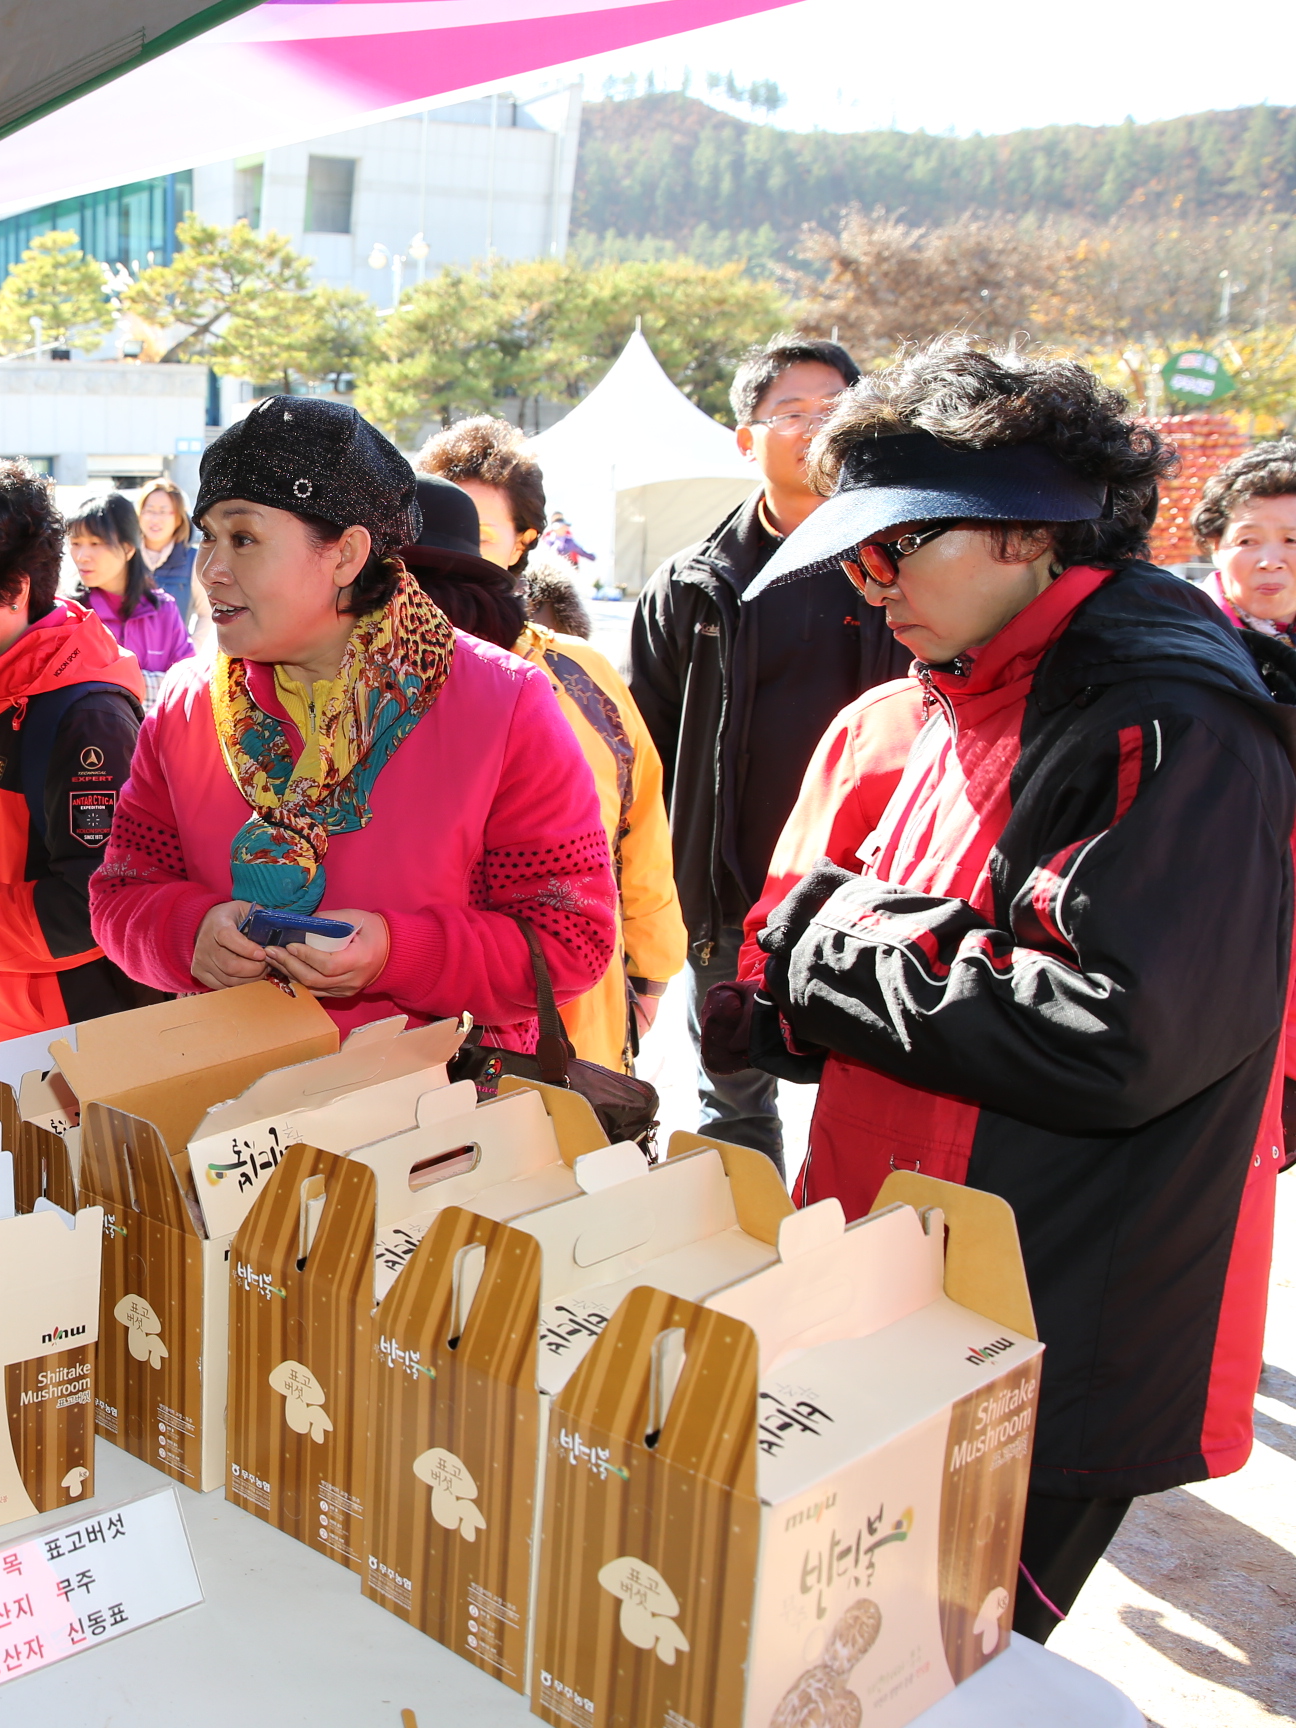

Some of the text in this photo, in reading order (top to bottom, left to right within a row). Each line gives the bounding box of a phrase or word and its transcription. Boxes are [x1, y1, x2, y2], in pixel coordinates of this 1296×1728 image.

[73, 795, 114, 805] ANTARCTICA
[237, 1261, 286, 1300] 반딧불
[126, 1312, 144, 1333] 버섯
[129, 1302, 150, 1320] 표고
[380, 1335, 436, 1380] 반딧불
[38, 1363, 92, 1387] Shiitake
[289, 1369, 312, 1389] 표고
[20, 1378, 91, 1406] Mushroom
[56, 1389, 91, 1409] 표고버섯
[284, 1380, 304, 1403] 버섯
[975, 1378, 1036, 1430] Shiitake
[950, 1406, 1032, 1473] Mushroom
[560, 1428, 629, 1481] 반딧불
[79, 1470, 88, 1479] kg
[430, 1469, 454, 1496] 버섯
[436, 1457, 463, 1481] 표고
[2, 1552, 24, 1576] 목
[44, 1512, 127, 1562] 표고버섯
[800, 1502, 908, 1621] 반딧불
[56, 1568, 97, 1603] 무주
[620, 1579, 648, 1612] 버섯
[626, 1567, 661, 1596] 표고
[67, 1601, 129, 1646] 신동표
